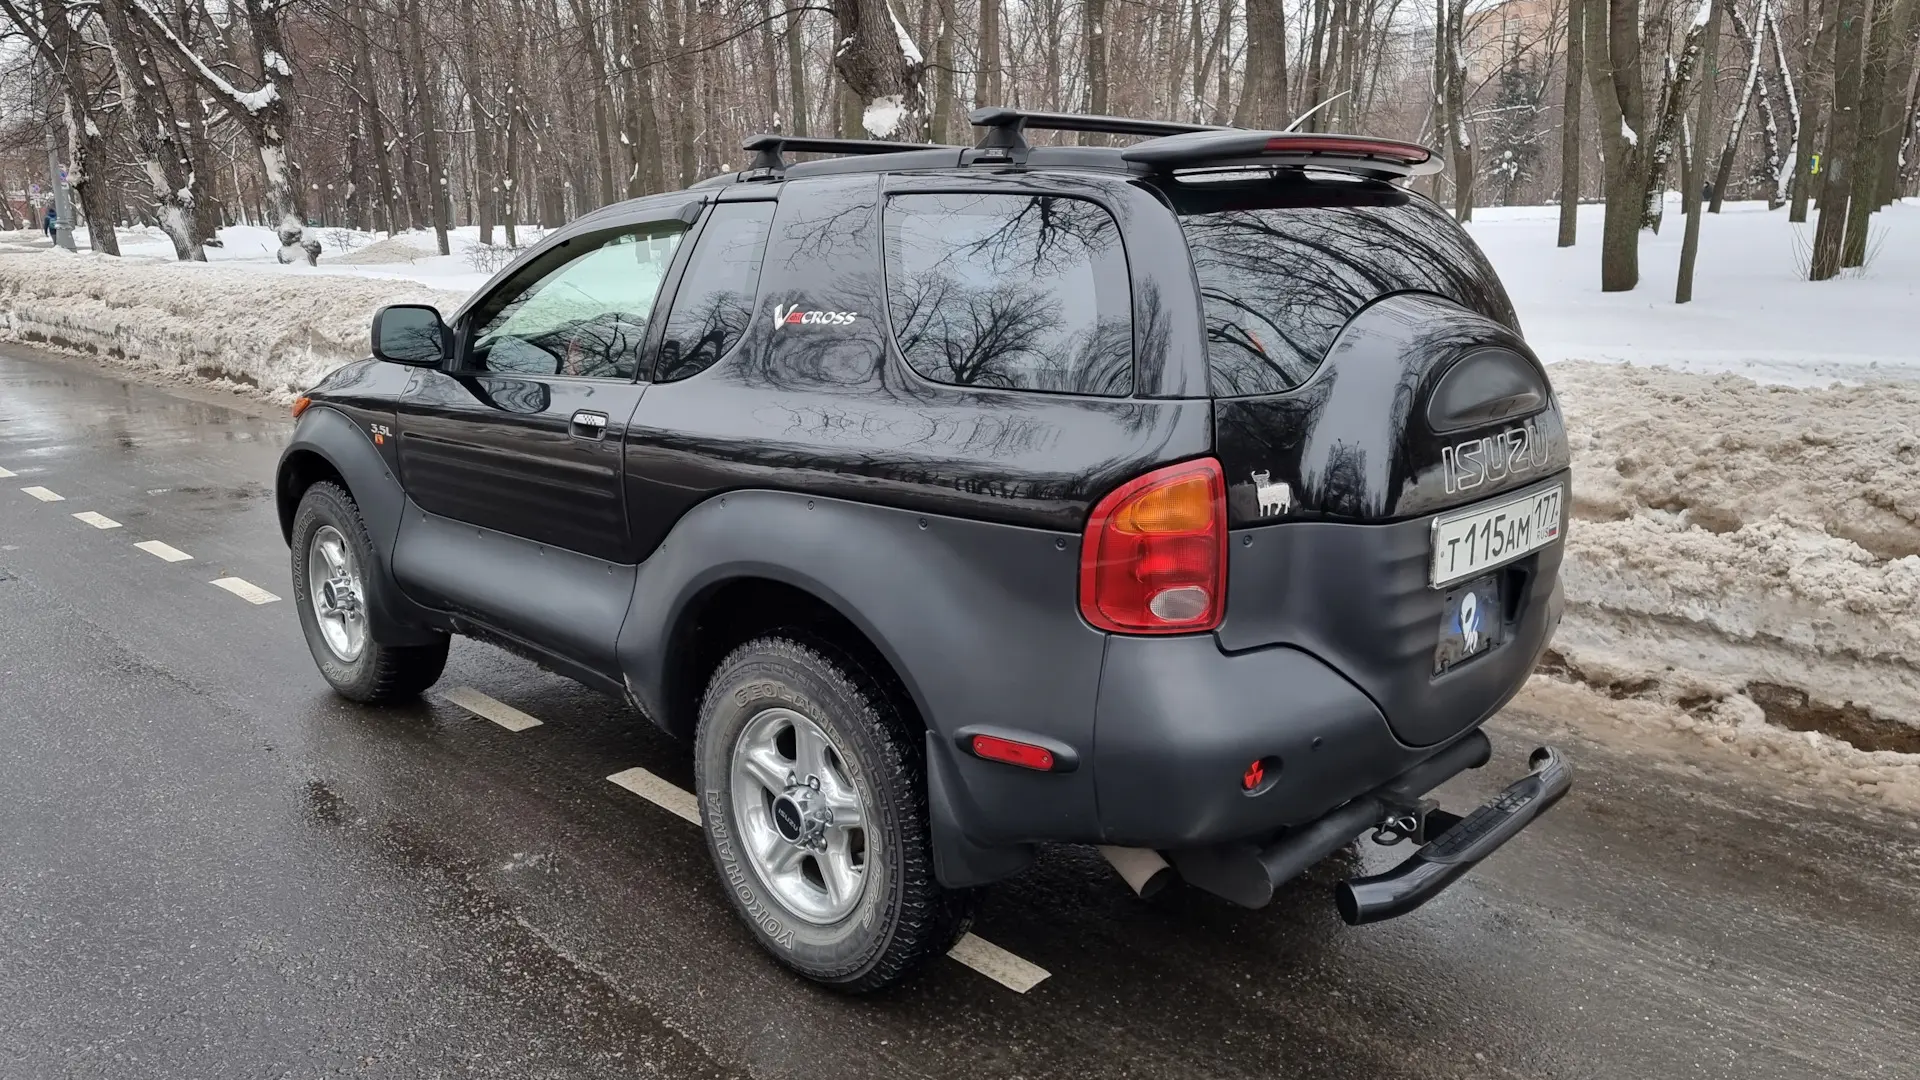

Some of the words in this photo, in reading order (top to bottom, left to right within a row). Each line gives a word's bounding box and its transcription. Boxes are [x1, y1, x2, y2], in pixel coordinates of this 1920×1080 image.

[1441, 424, 1548, 494] ISUZU
[1535, 492, 1558, 530] 177
[1536, 527, 1549, 540] RUS
[778, 808, 798, 831] ISUZU
[706, 789, 796, 950] YOKOHAMA
